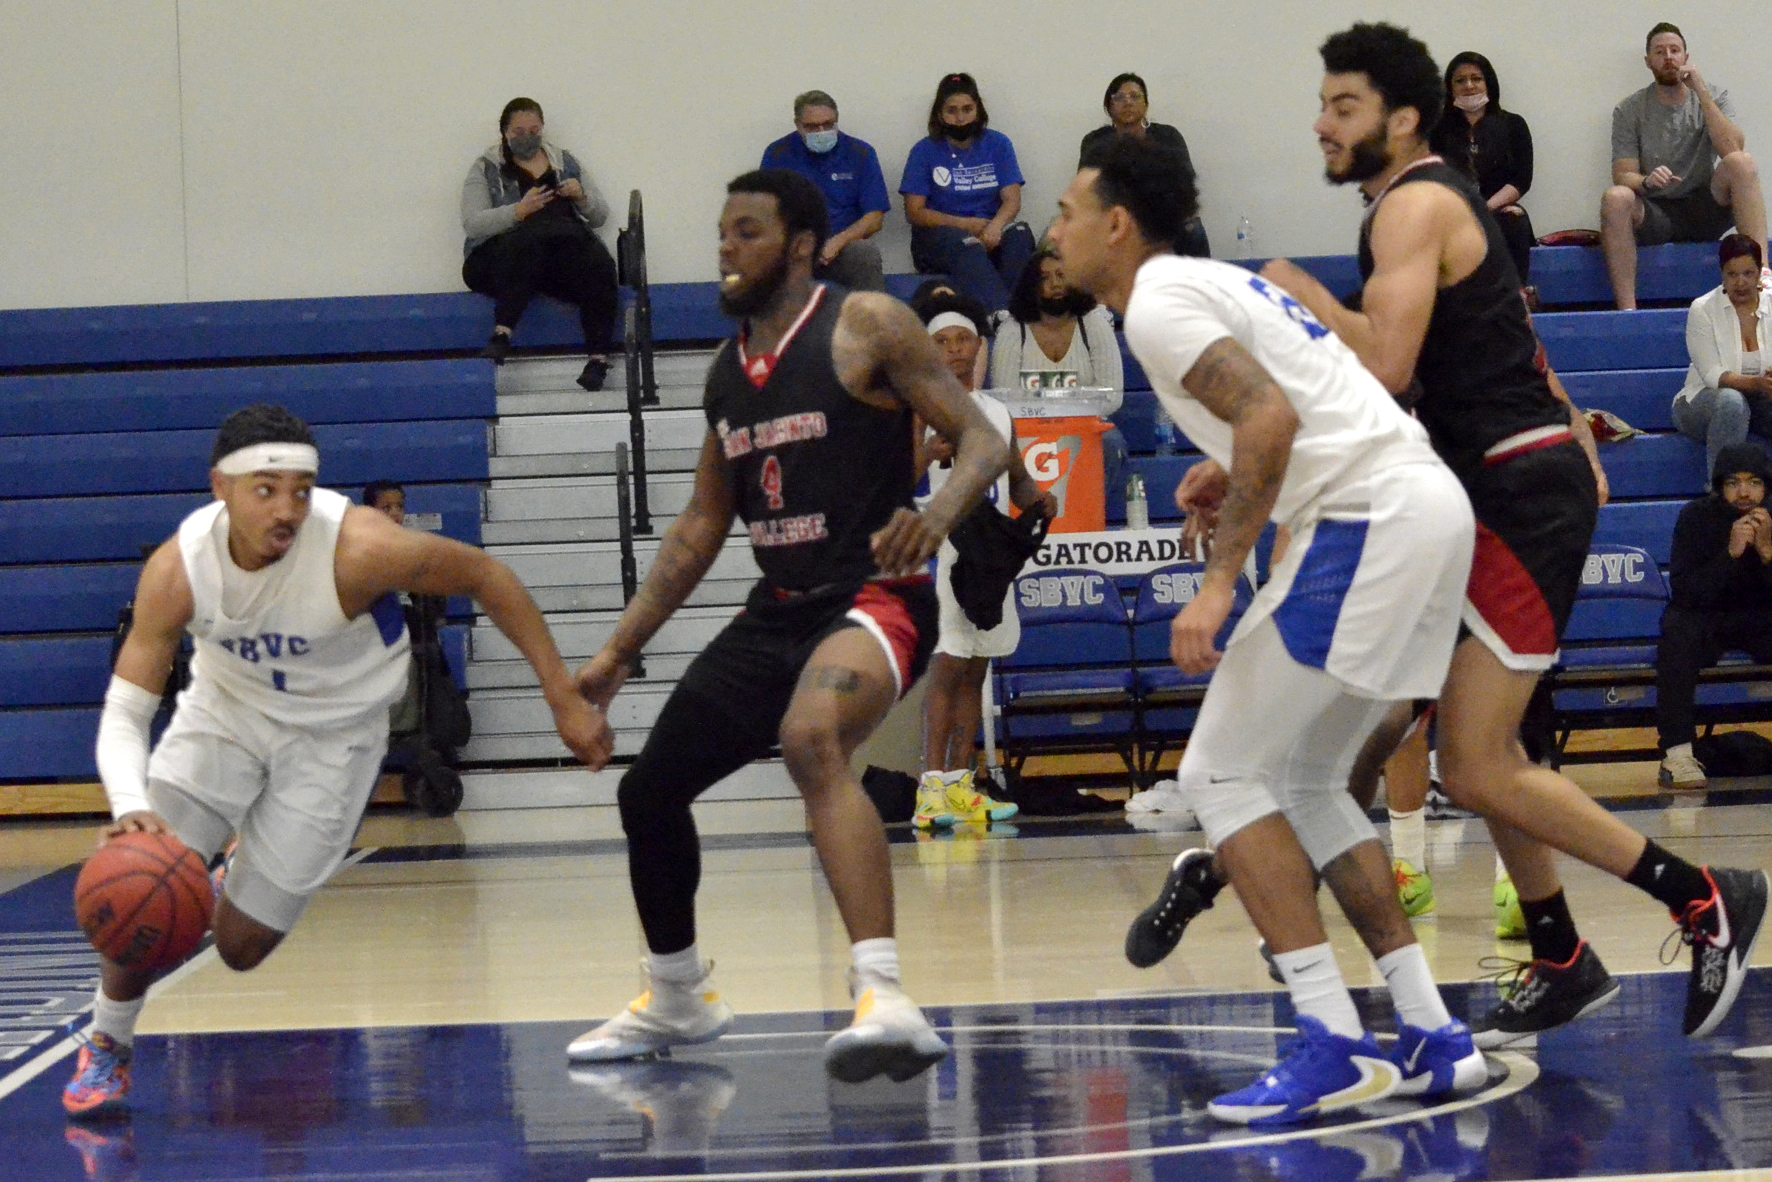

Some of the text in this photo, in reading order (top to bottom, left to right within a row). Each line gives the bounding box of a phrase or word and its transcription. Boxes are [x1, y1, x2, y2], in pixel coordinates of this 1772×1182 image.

[954, 174, 996, 185] Valley College
[1020, 406, 1047, 417] SBVC
[1024, 442, 1060, 482] G
[761, 455, 784, 509] 4
[1581, 553, 1645, 585] BVC
[1019, 575, 1105, 607] SBVC
